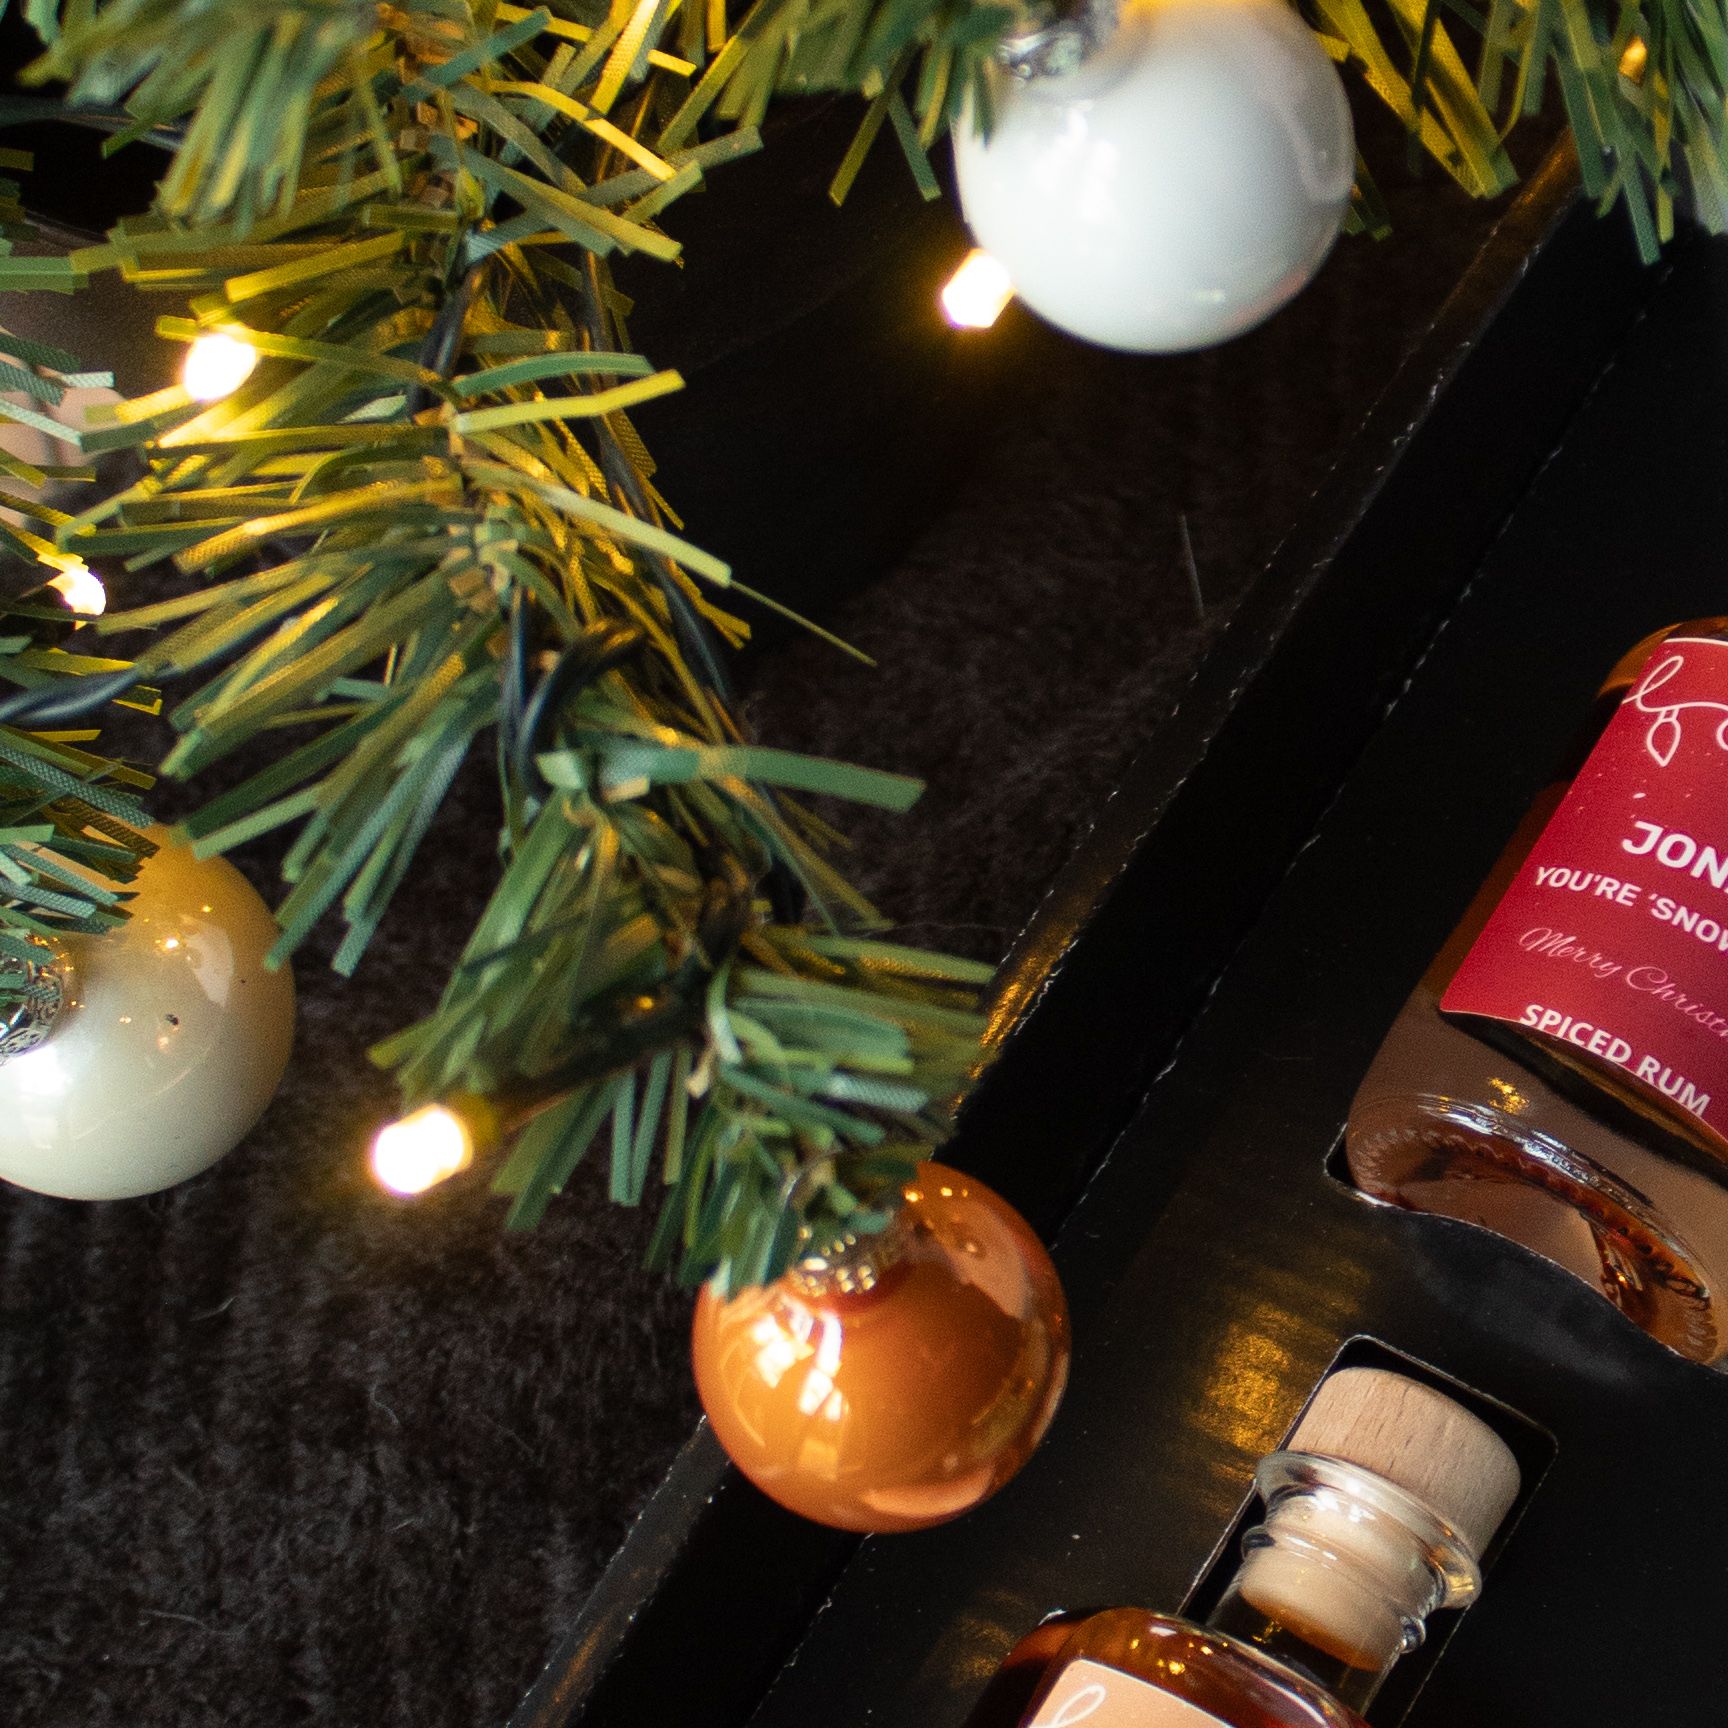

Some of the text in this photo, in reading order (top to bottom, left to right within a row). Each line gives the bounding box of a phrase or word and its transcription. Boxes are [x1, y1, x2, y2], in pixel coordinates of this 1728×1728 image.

[1533, 866, 1642, 908] YOU'RE
[1518, 927, 1622, 979] Merry
[1520, 1004, 1710, 1117] SPICED RUM
